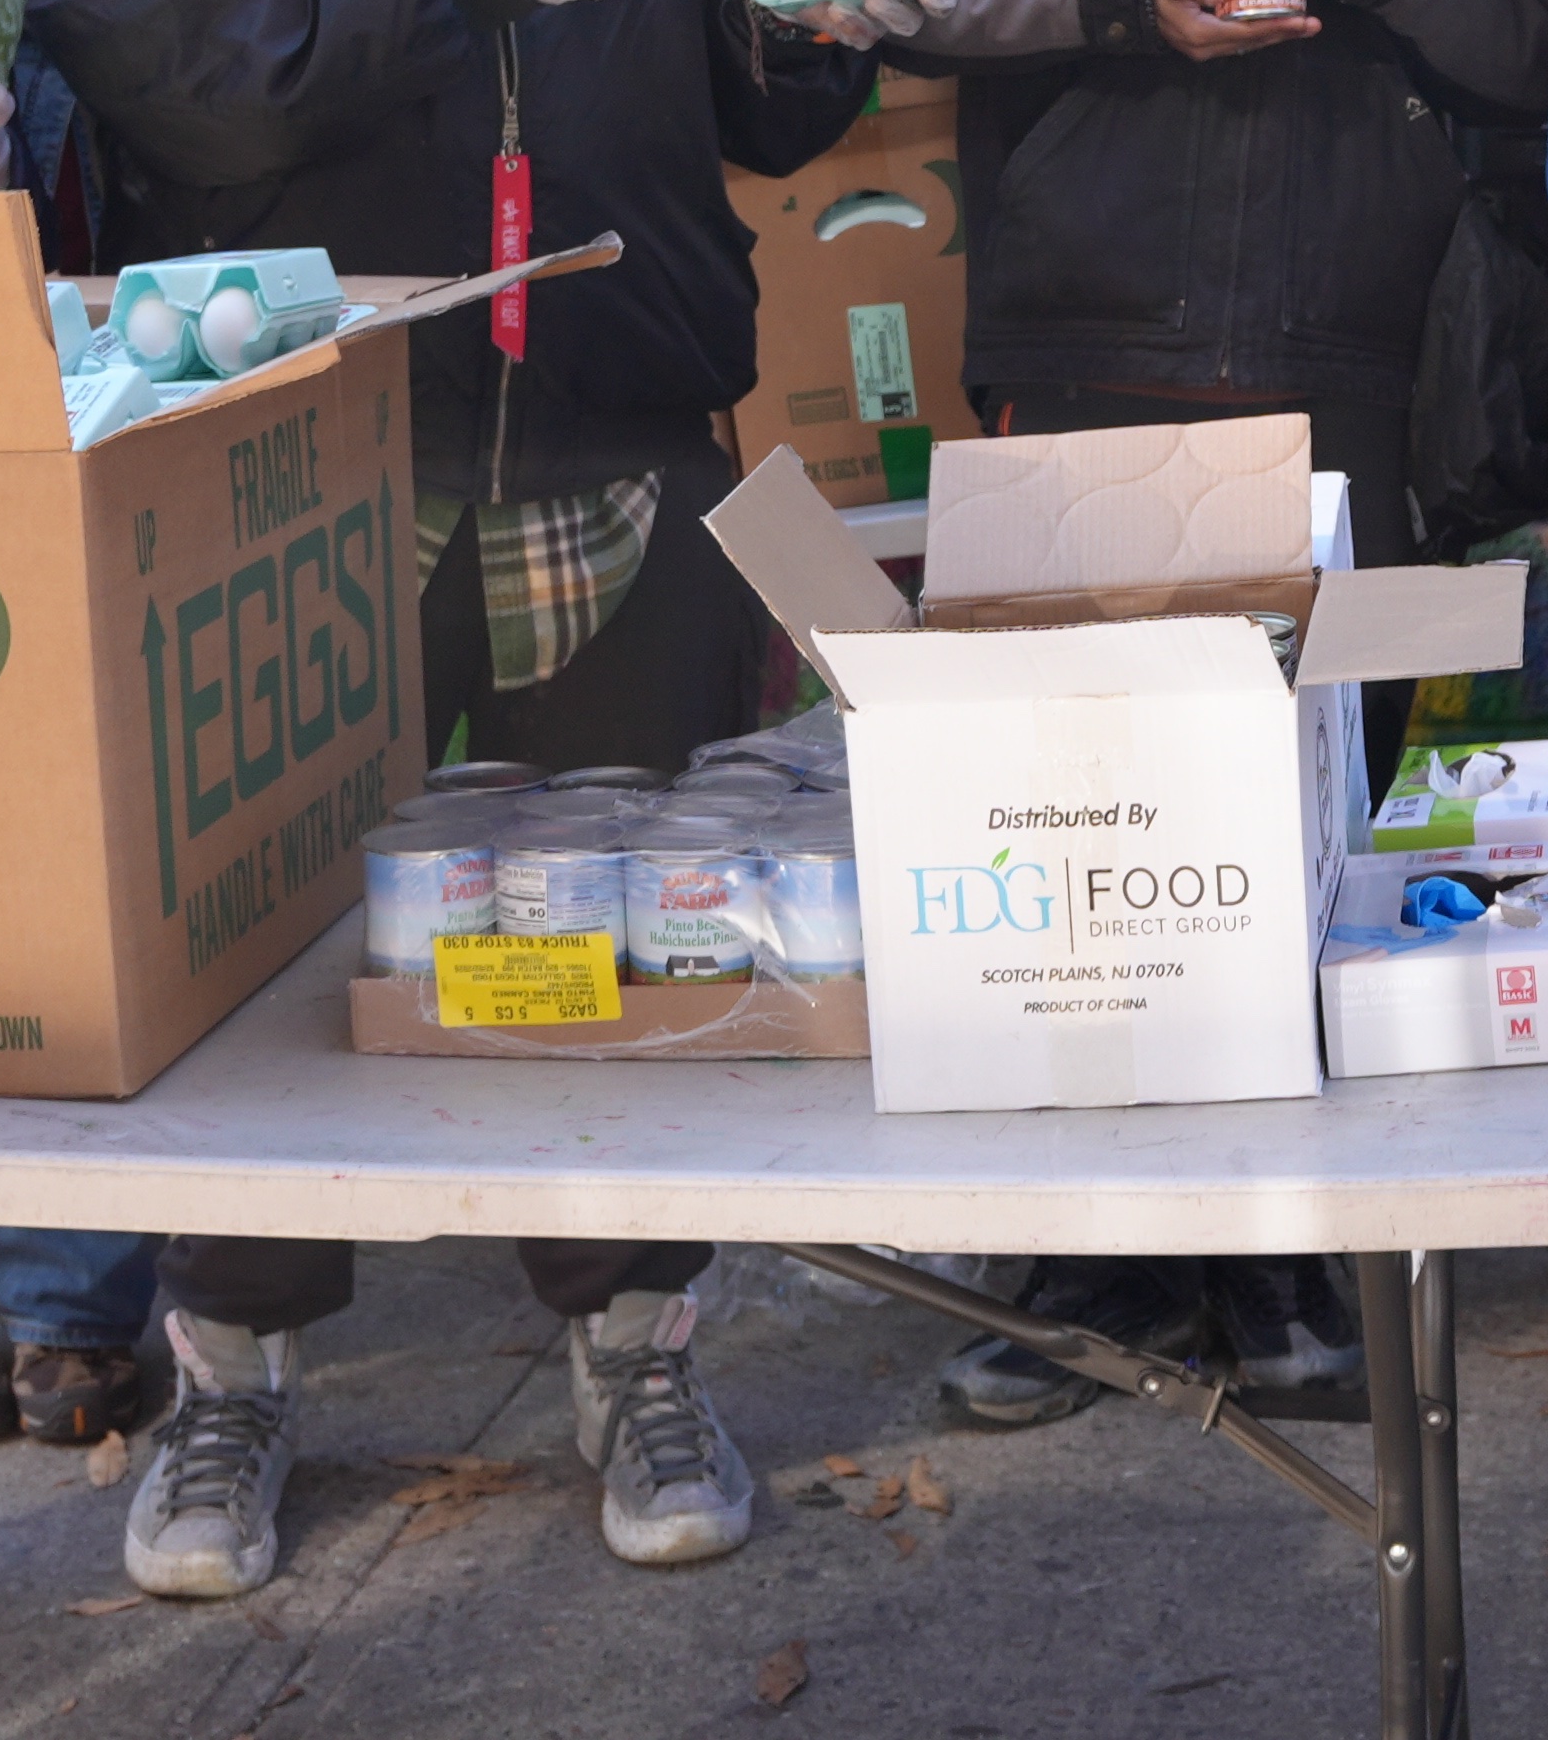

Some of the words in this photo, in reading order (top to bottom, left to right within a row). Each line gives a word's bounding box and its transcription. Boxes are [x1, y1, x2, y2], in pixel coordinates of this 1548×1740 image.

[228, 407, 324, 550] FRAGILE
[134, 507, 158, 578] UP
[176, 498, 377, 840] EGGS
[987, 801, 1121, 831] Distributed
[1127, 802, 1158, 831] By
[185, 825, 277, 976] HANDLE
[279, 785, 336, 894] WITH
[340, 750, 390, 853] CARE
[660, 871, 726, 891] SUNNY
[1086, 863, 1251, 912] FOOD
[658, 889, 730, 910] FARM
[905, 861, 1056, 935] FDG
[665, 918, 694, 932] Pinto
[1088, 917, 1168, 938] DIRECT
[1175, 914, 1252, 935] GROUP
[443, 936, 469, 949] 030
[475, 935, 512, 948] STOP
[538, 935, 590, 948] TRUCK
[650, 930, 712, 948] Habichuelas
[980, 967, 1044, 985] SCOTCH
[1048, 965, 1107, 983] PLAINS,
[1111, 964, 1132, 980] NJ
[1135, 962, 1185, 979] 07076
[464, 1006, 473, 1021] 5
[1023, 999, 1084, 1015] PRODUCT
[1086, 998, 1104, 1012] OF
[1107, 996, 1148, 1011] CHINA
[1509, 1017, 1532, 1036] M
